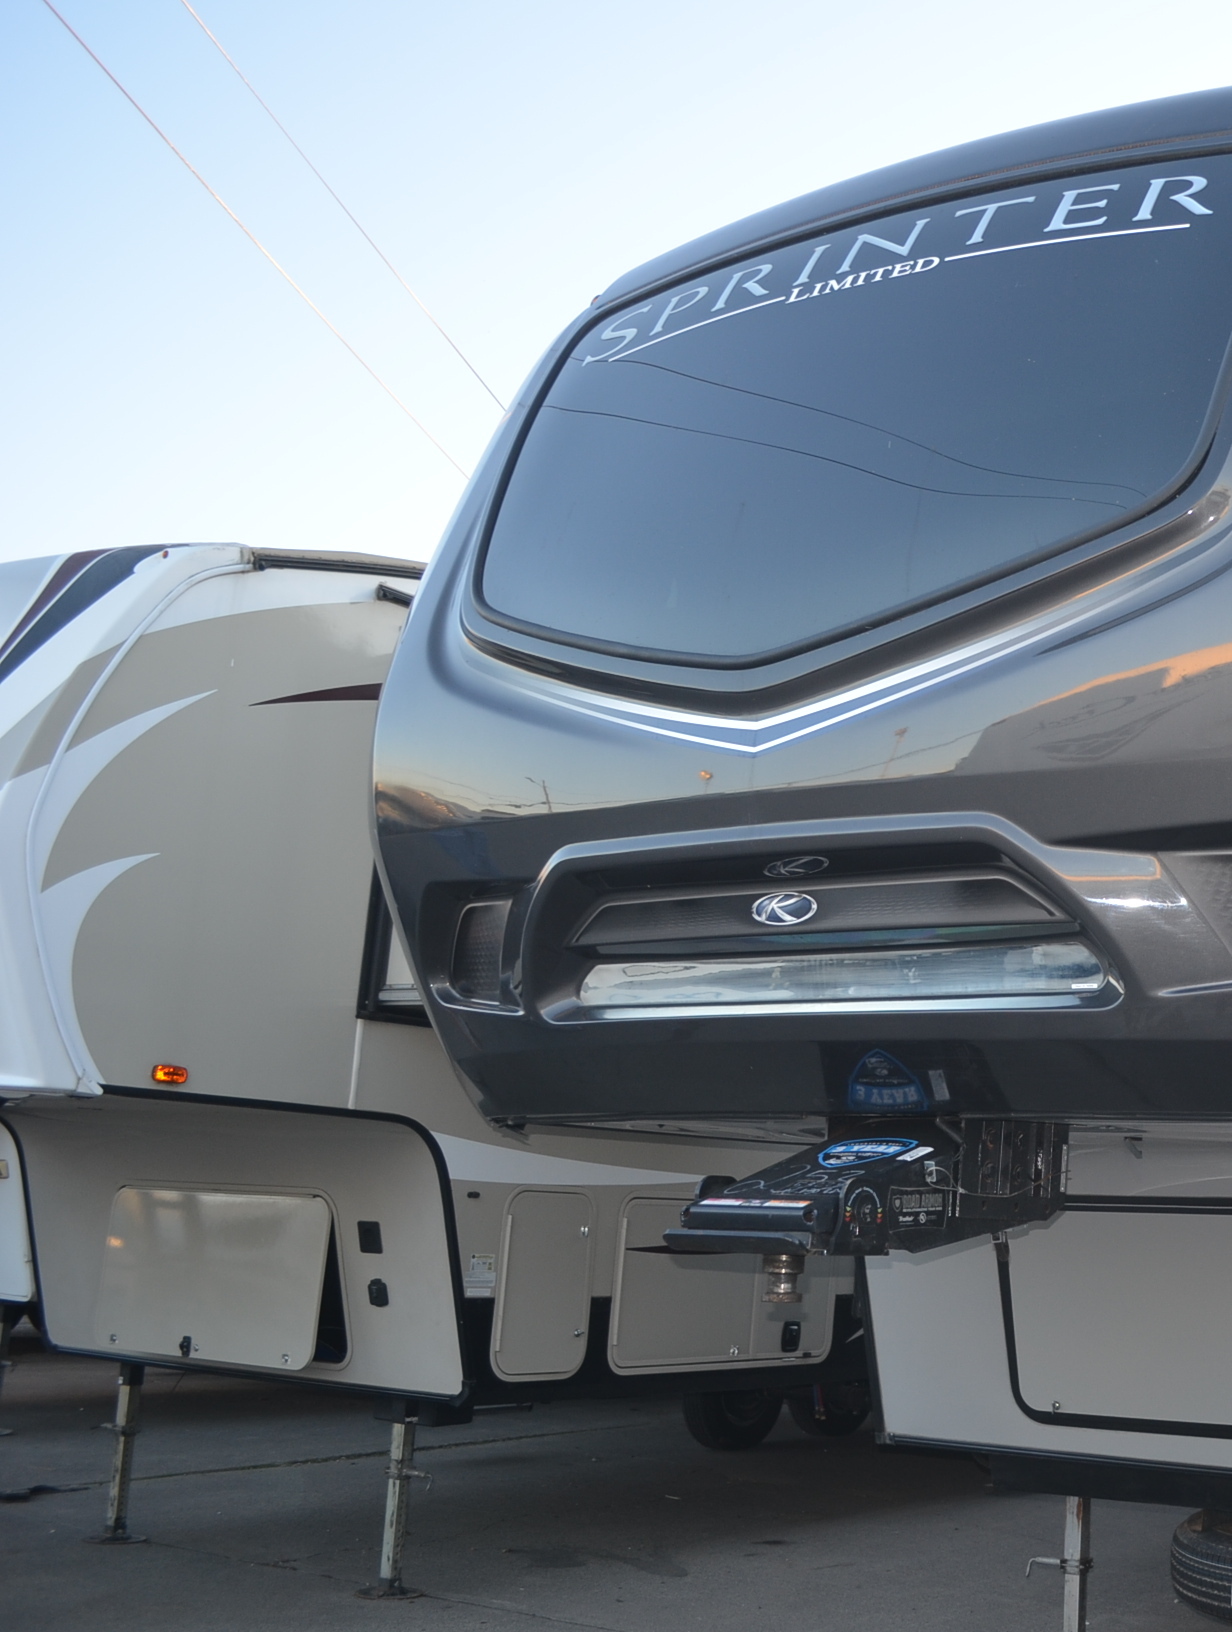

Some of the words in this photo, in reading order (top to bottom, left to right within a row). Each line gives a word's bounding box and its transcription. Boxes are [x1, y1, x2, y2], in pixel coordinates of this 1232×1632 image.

[582, 174, 1214, 367] SPRINTER
[785, 255, 941, 305] LIMITED
[756, 893, 813, 925] K
